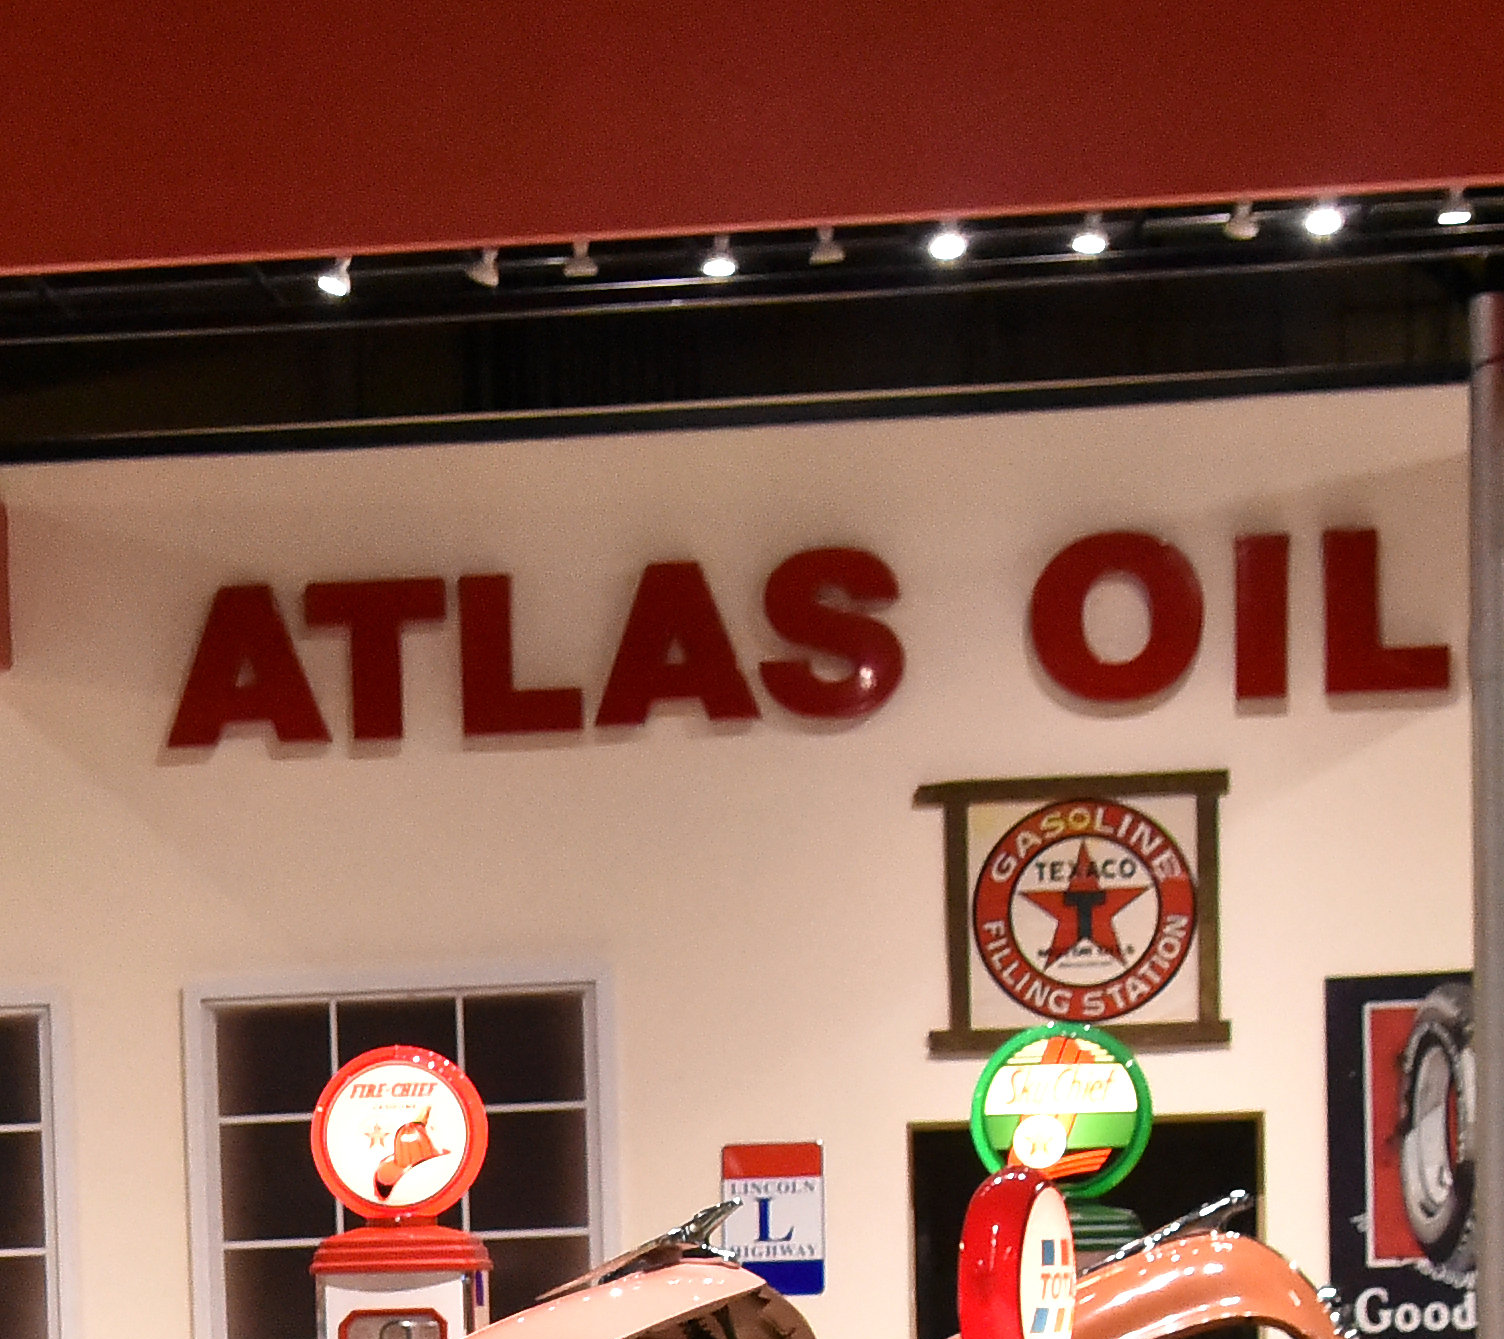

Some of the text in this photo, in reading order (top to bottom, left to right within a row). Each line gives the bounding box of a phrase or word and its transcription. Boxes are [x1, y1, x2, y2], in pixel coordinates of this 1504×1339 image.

[167, 528, 1452, 750] ATLAS OIL
[992, 807, 1182, 884] GASOLINE
[1034, 858, 1137, 881] TEXACO
[982, 914, 1189, 1016] FILLING STATION
[349, 1082, 439, 1099] FIRE-CHIEF
[730, 1180, 816, 1196] LINCOLN
[755, 1196, 795, 1243] L
[729, 1244, 817, 1259] HIGHWAY
